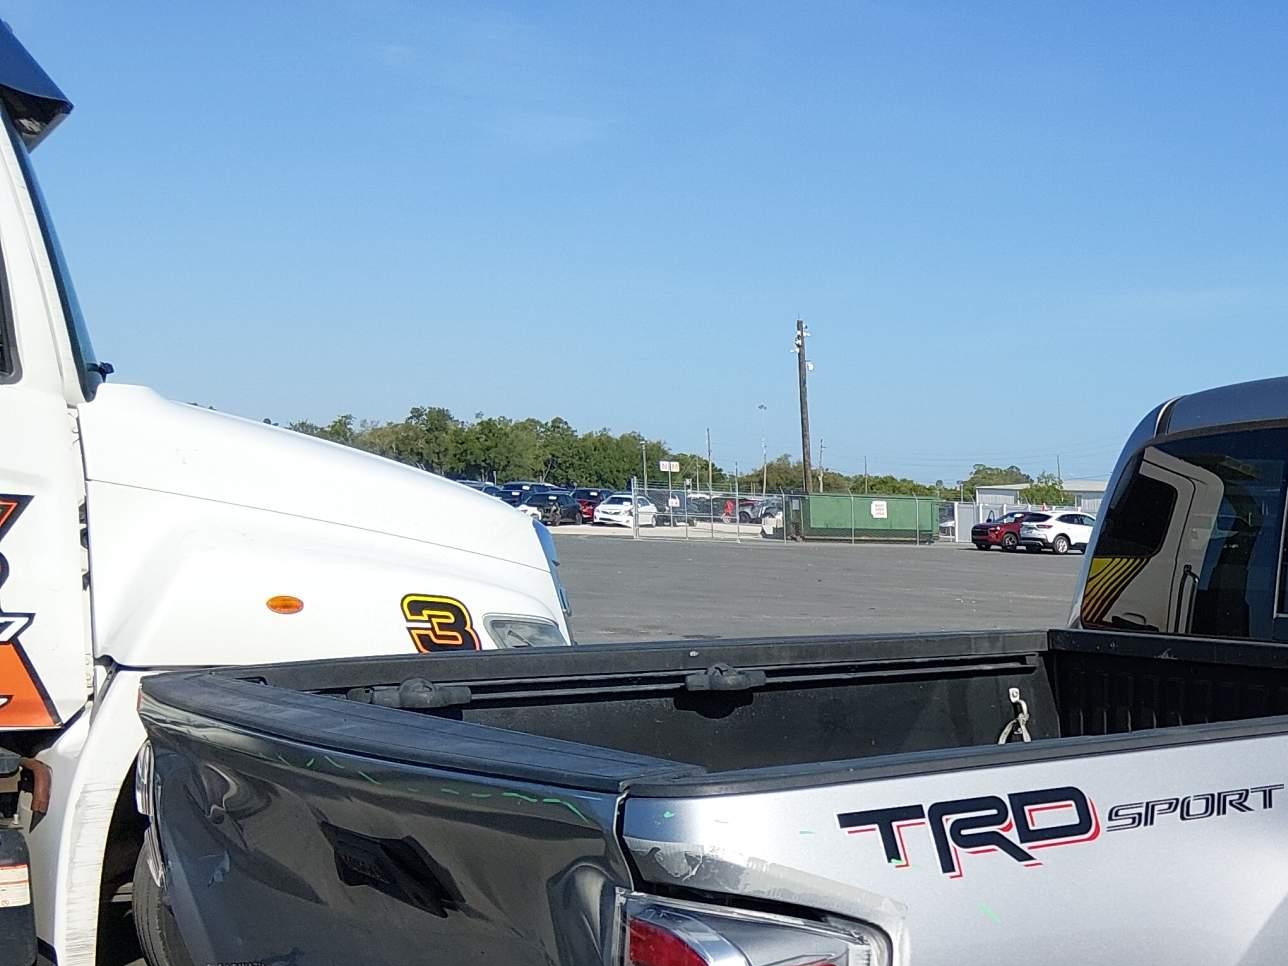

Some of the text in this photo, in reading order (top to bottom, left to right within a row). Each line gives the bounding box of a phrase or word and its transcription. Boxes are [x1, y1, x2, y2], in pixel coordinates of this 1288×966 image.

[400, 593, 482, 655] 3
[836, 783, 1285, 880] TRD SPORT
